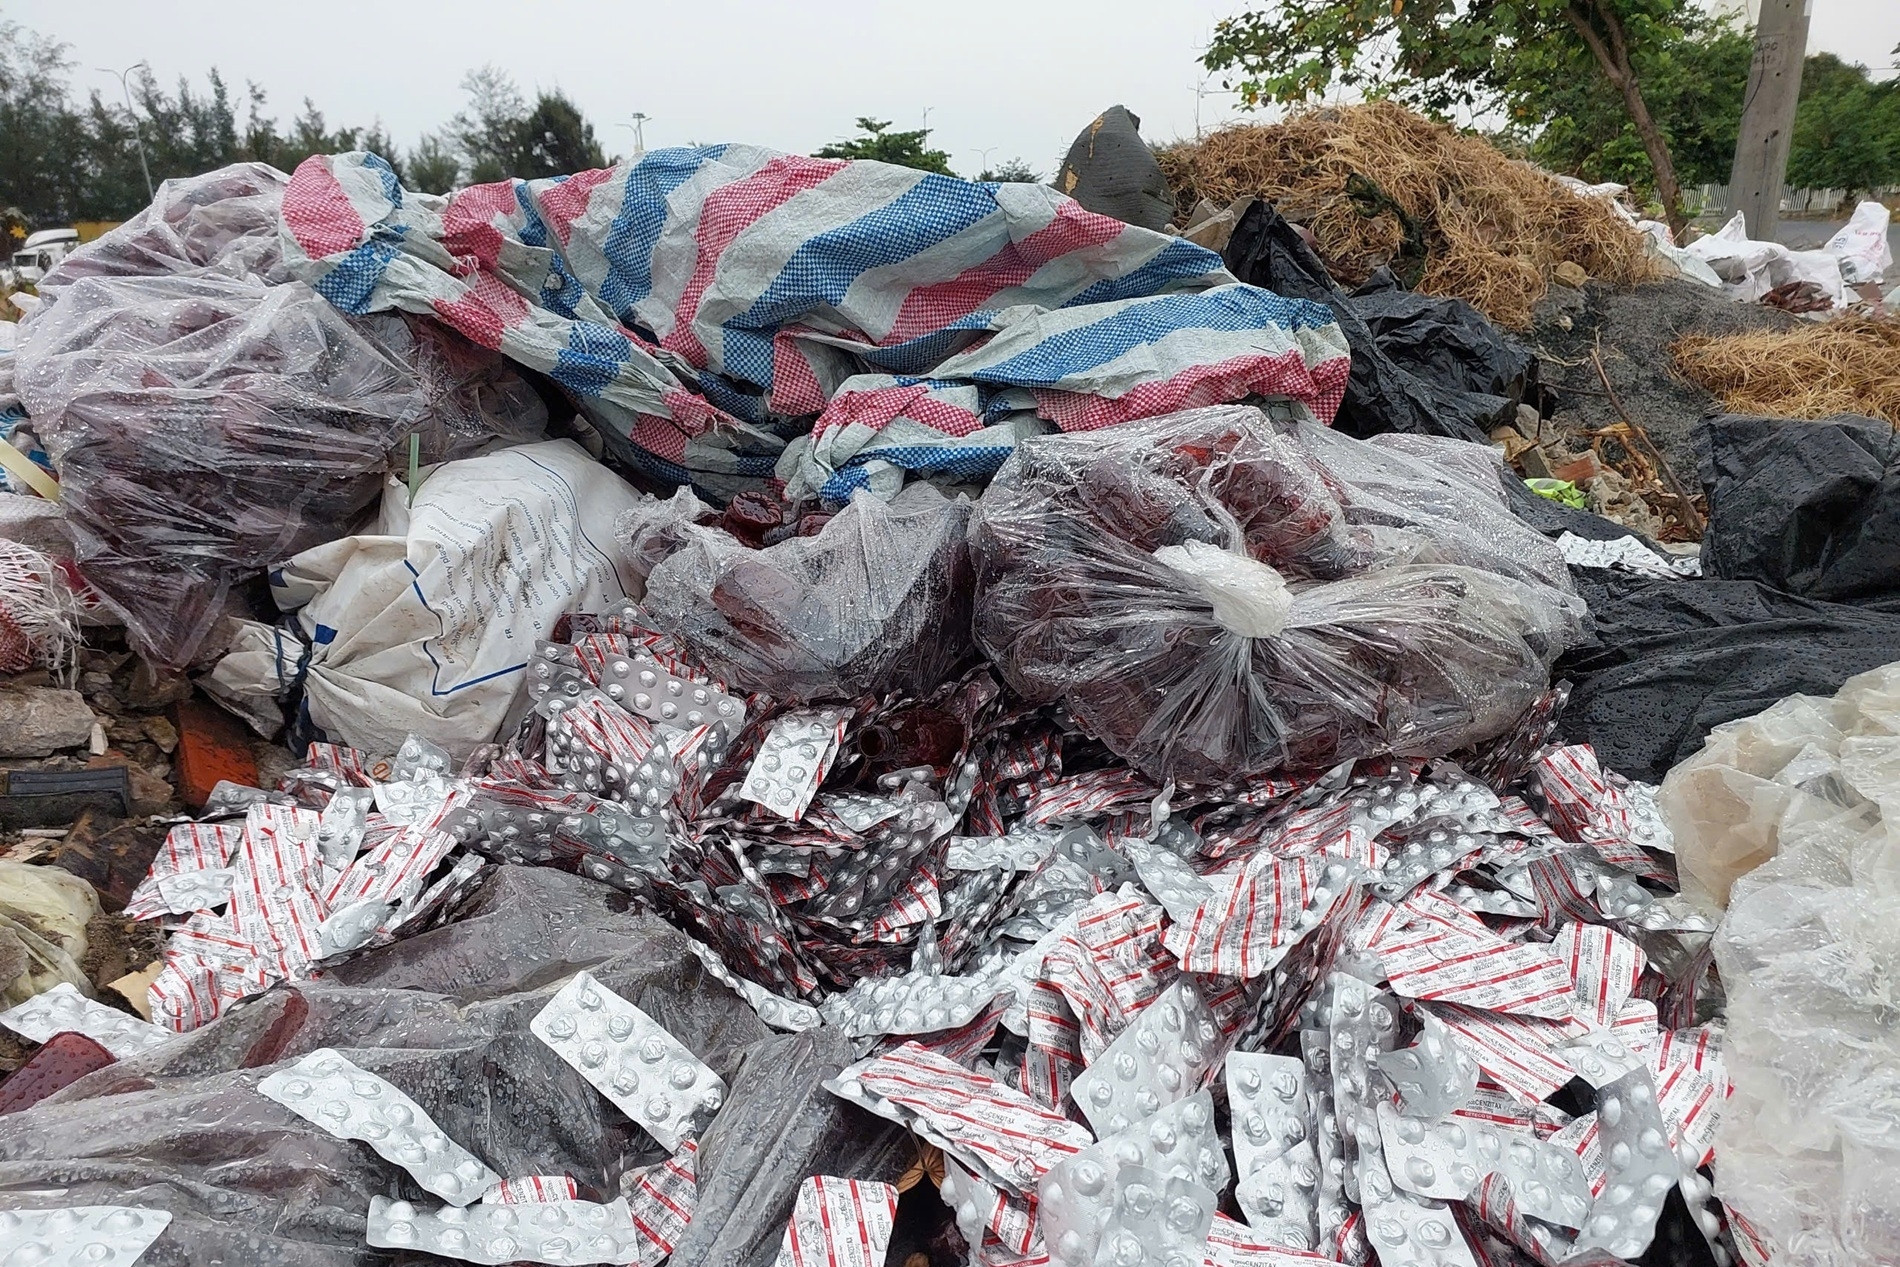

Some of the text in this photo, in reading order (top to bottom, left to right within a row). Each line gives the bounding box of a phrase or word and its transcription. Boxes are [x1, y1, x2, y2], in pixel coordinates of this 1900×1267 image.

[511, 532, 523, 555] luogo
[538, 543, 545, 551] in
[435, 541, 450, 564] place.
[445, 565, 453, 581] dry
[554, 570, 563, 580] en
[449, 581, 457, 596] and
[547, 583, 561, 600] Voor
[562, 580, 573, 596] Koel
[453, 597, 467, 614] cool
[602, 593, 610, 604] PT
[504, 628, 514, 639] FR
